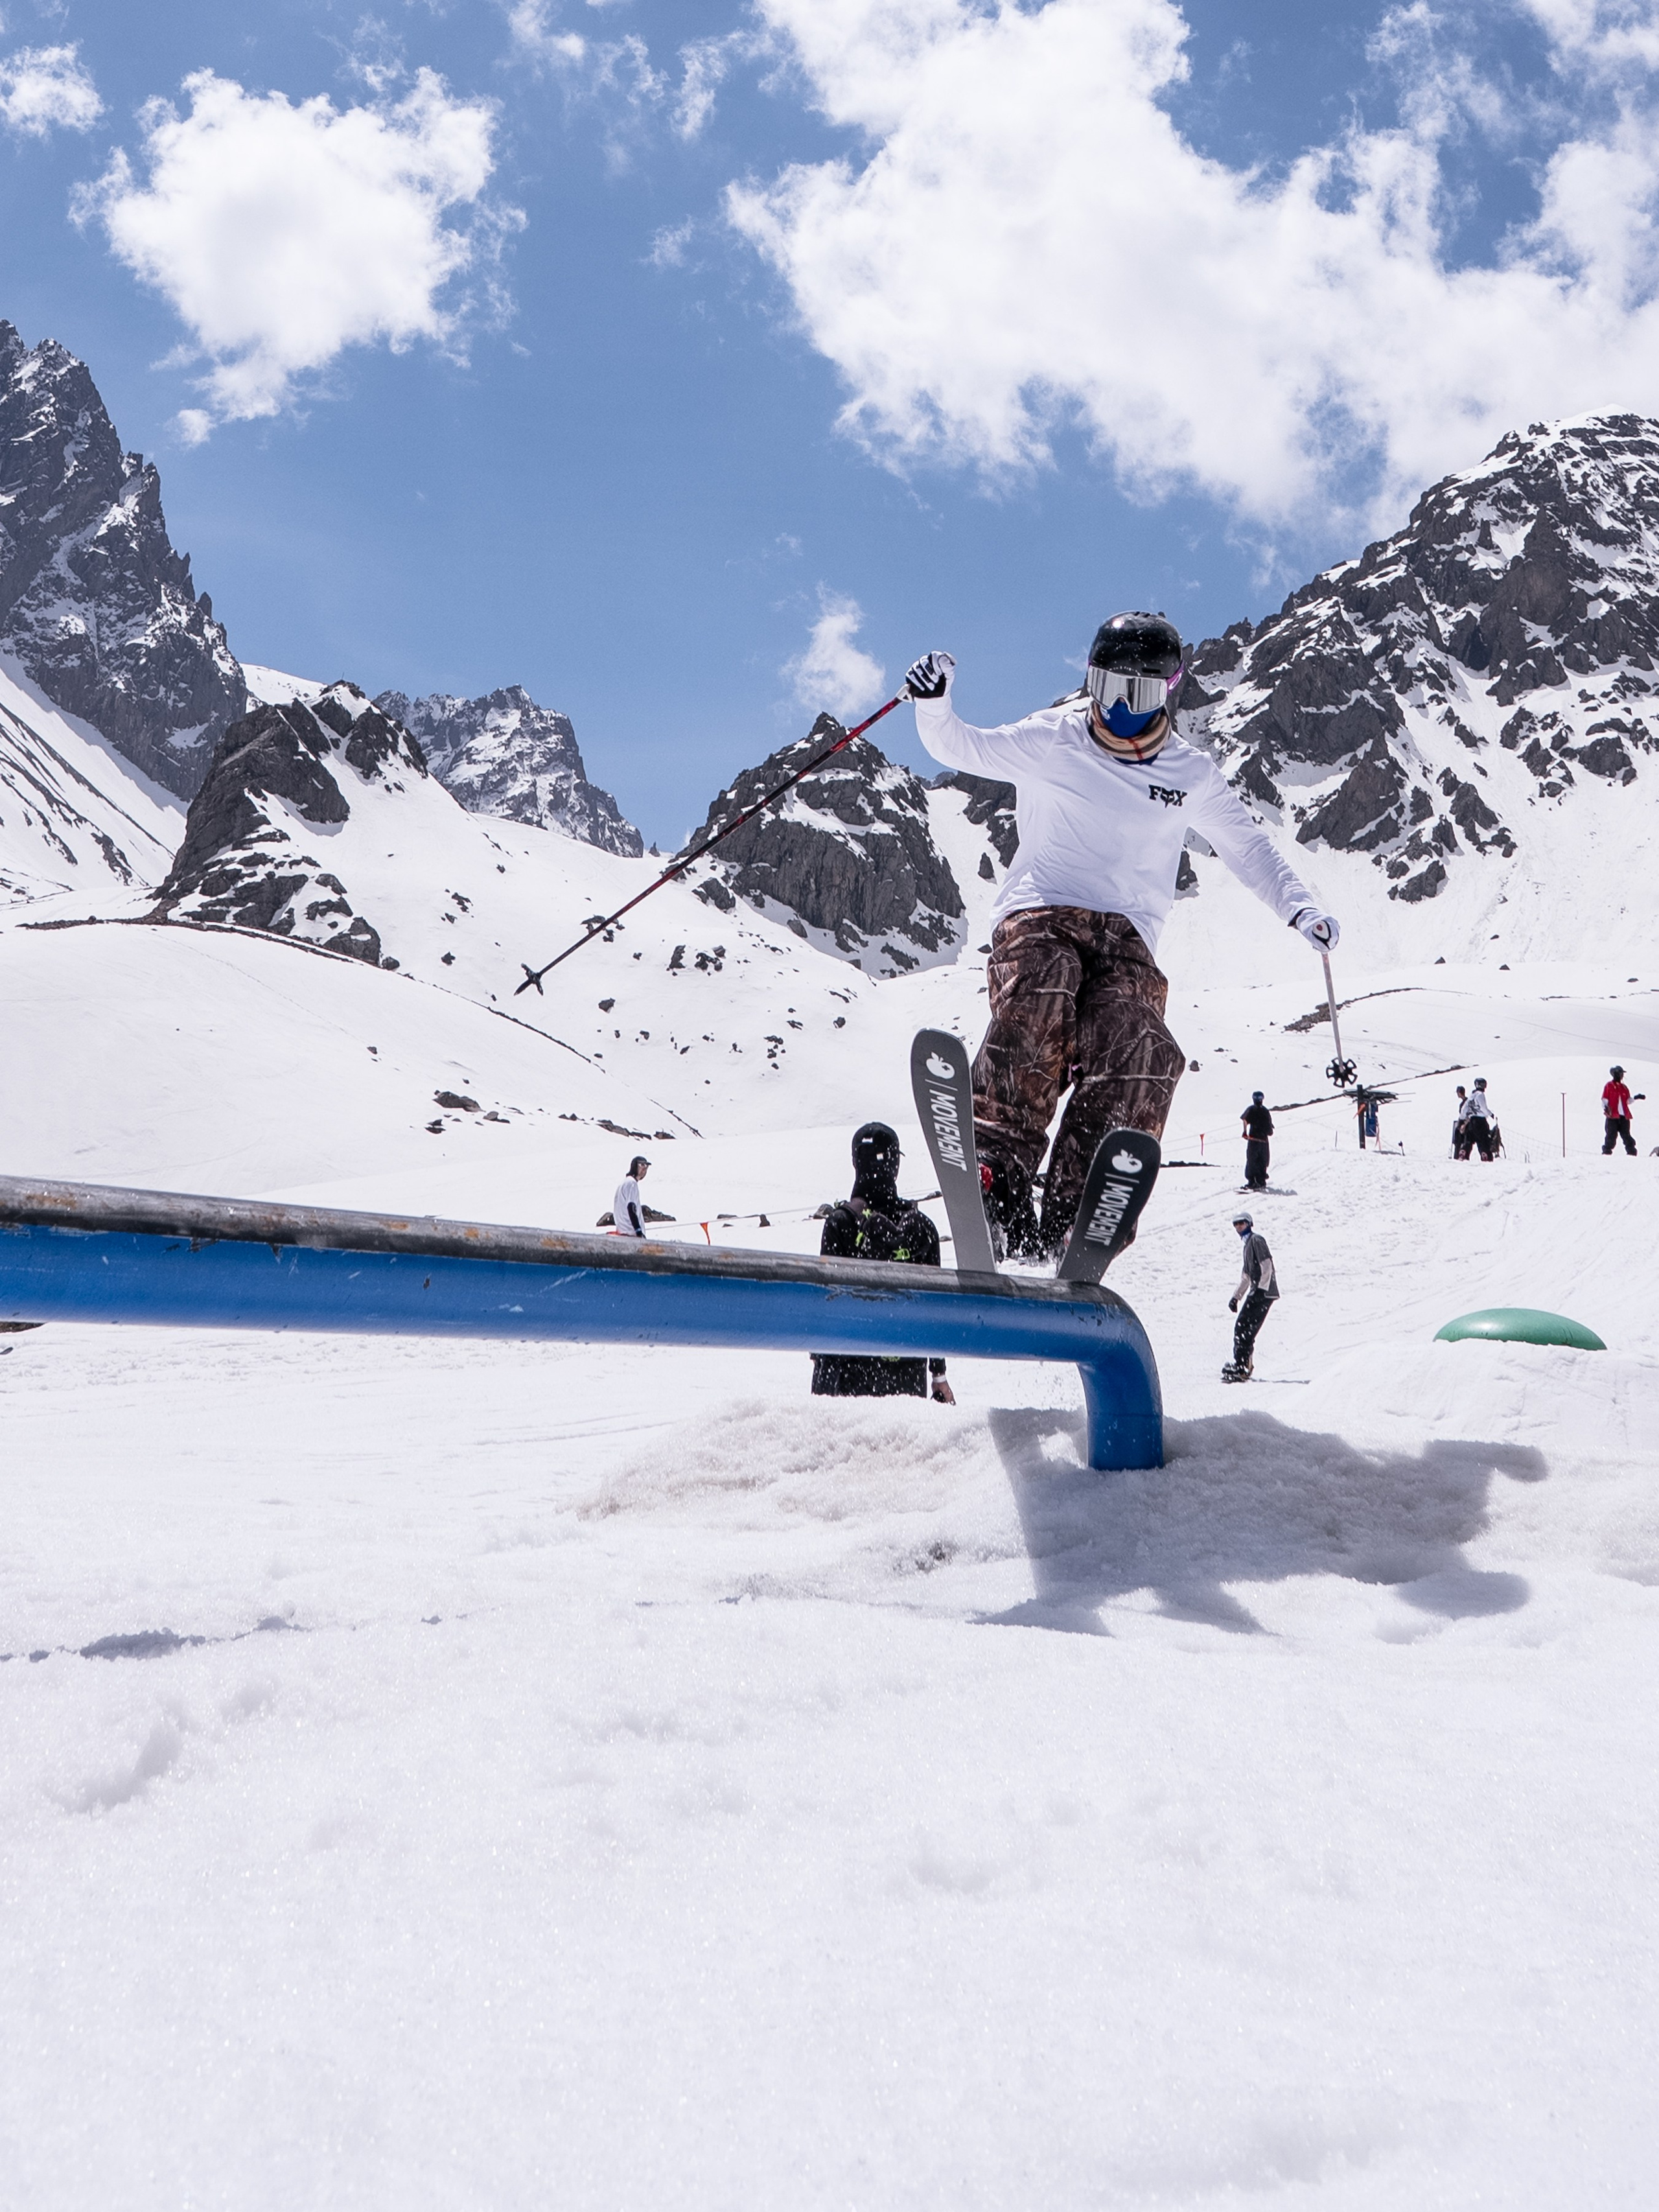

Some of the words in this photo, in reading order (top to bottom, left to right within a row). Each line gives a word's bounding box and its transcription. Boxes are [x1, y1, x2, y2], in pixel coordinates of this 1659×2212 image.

[1148, 784, 1188, 808] FOX
[929, 1089, 968, 1172] MOVEMENT
[1084, 1182, 1133, 1246] MOVEMENT
